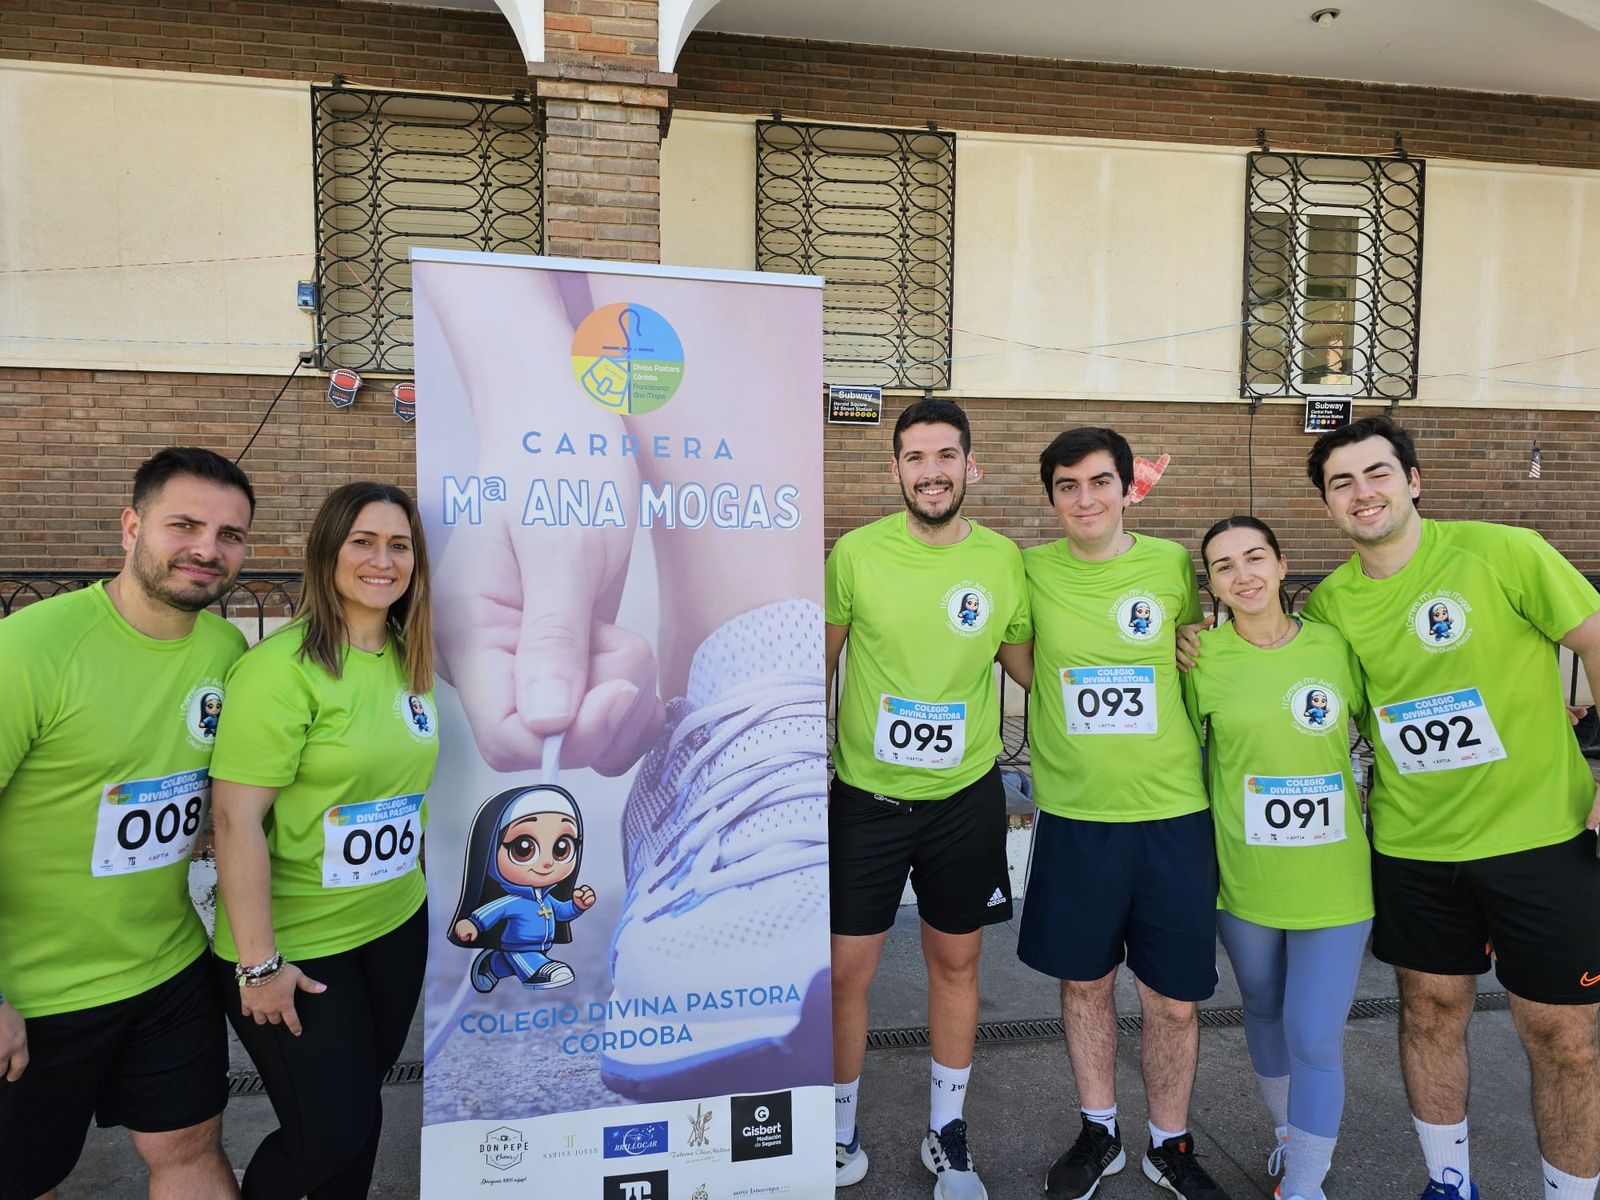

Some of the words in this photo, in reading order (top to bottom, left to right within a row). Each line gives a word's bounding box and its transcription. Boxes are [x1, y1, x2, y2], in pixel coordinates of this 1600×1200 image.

[838, 391, 872, 401] Subway
[1314, 402, 1344, 411] Subway
[522, 431, 733, 460] CARRERA
[521, 478, 626, 528] ANA
[639, 481, 801, 530] MOGAS
[914, 704, 948, 712] COLEGIO
[1078, 688, 1144, 718] 093
[1402, 708, 1433, 720] DIVINA
[1434, 700, 1476, 716] PASTORA
[1415, 696, 1454, 710] COLEGIO
[900, 708, 926, 719] DIVINA
[890, 720, 952, 752] 095
[1399, 716, 1482, 755] 092
[161, 773, 197, 789] COLEGIO
[1286, 778, 1325, 786] COLEGIO
[1303, 784, 1339, 794] PASTORA
[139, 790, 172, 802] DIVINA
[356, 812, 388, 822] DIVINA
[389, 804, 416, 818] PASTORA
[376, 798, 407, 812] COLEGIO
[1265, 797, 1330, 829] 091
[118, 796, 202, 850] 008
[343, 819, 414, 866] 006
[460, 1004, 578, 1034] COLEGIO
[588, 994, 678, 1023] DIVINA
[687, 983, 801, 1012] PASTORA
[562, 1023, 693, 1055] CÓRDOBA
[742, 1122, 782, 1136] Gisbert
[480, 1144, 498, 1153] DON
[504, 1142, 528, 1152] PEPE
[614, 1140, 658, 1151] BRILLOCAR
